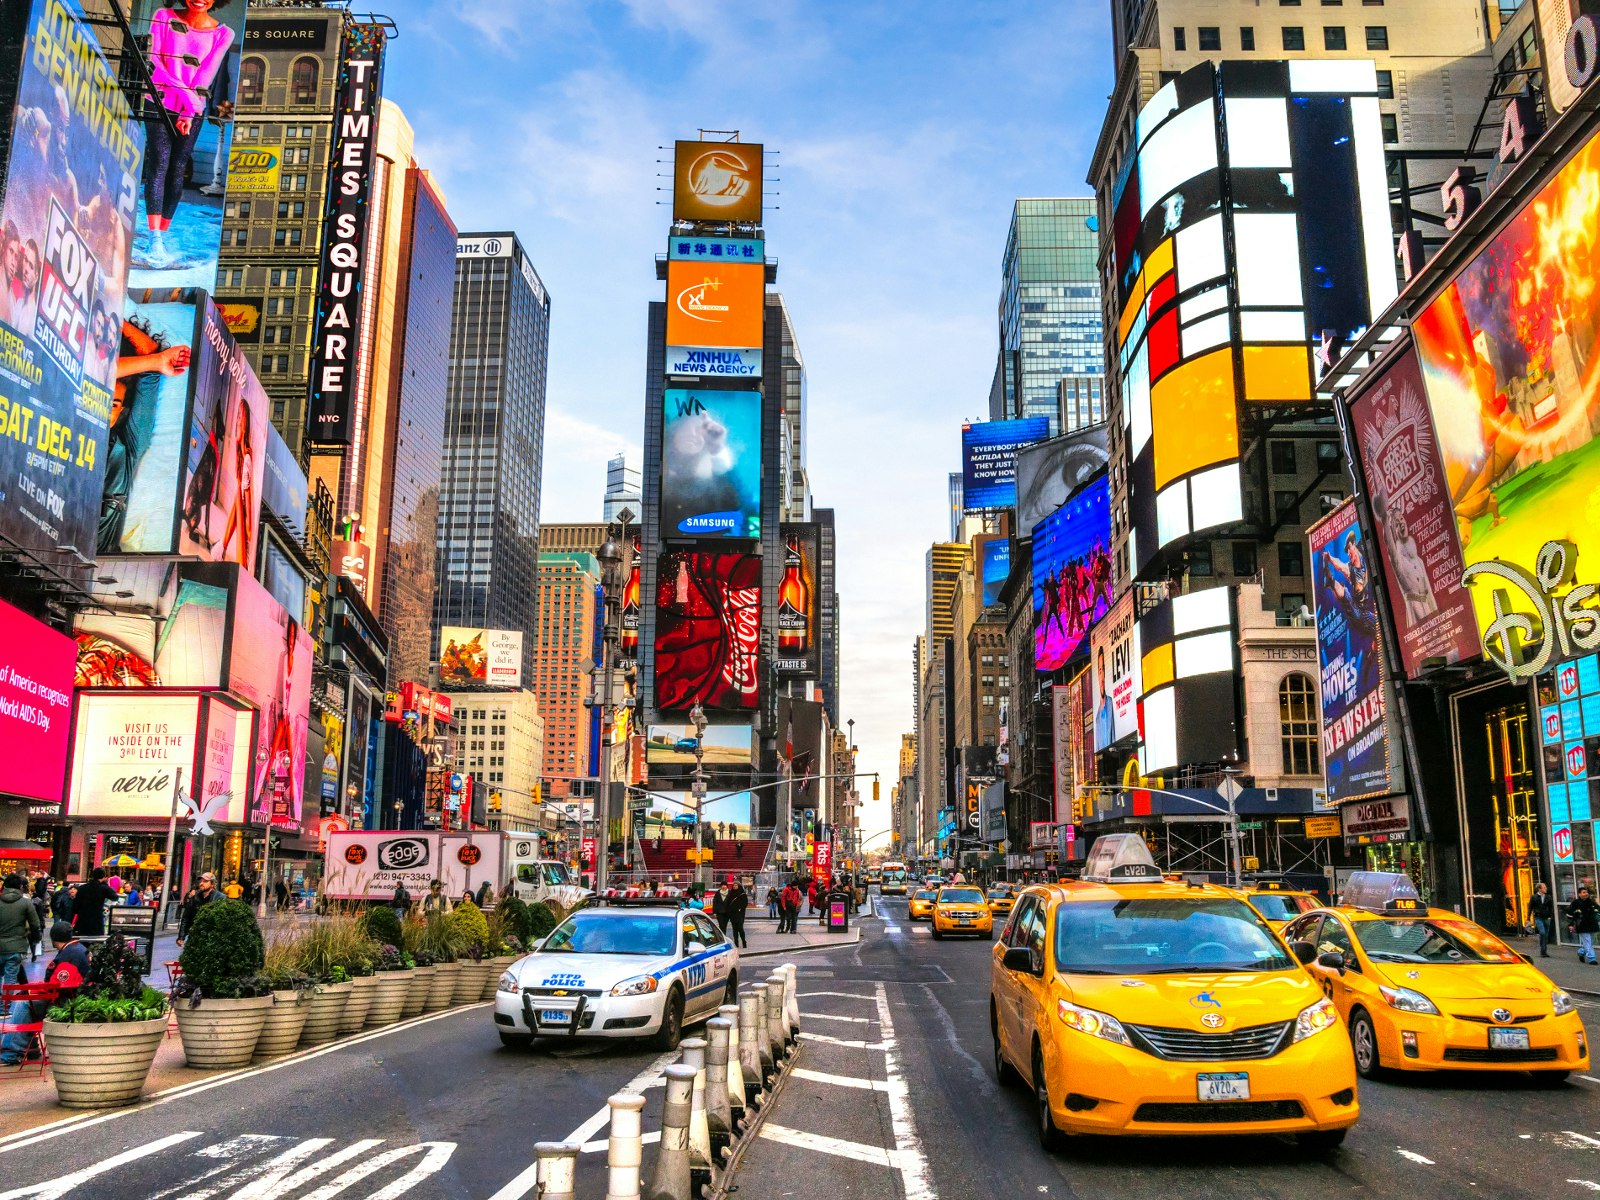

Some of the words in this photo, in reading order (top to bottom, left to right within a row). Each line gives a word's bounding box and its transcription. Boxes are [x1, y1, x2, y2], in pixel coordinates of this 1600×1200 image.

[265, 30, 315, 39] SQUARE
[38, 0, 130, 130] JOHNSON
[33, 22, 141, 179] BENAVIDEZ
[340, 60, 374, 196] TIMES
[118, 171, 137, 232] 2
[46, 211, 97, 308] FOX
[678, 242, 755, 257] 新华通讯社
[321, 213, 358, 392] SQUARE
[41, 281, 88, 354] UFC
[36, 318, 82, 382] SATURDAY
[687, 351, 742, 365] XINHUA
[674, 363, 707, 373] NEWS
[709, 364, 755, 375] AGENCY
[37, 415, 73, 463] DEC.
[76, 433, 97, 472] 14
[1383, 434, 1412, 474] GREAT
[971, 453, 1001, 462] MATILDA
[975, 462, 994, 470] THEY
[974, 471, 997, 479] KNOW
[998, 469, 1015, 477] HOW
[1385, 452, 1418, 494] COMET
[19, 472, 36, 499] LIVE
[36, 487, 47, 507] ON
[46, 488, 66, 522] FOX
[686, 518, 735, 528] SAMSUNG
[1432, 555, 1459, 580] ORIGINAL
[491, 641, 518, 650] George,
[501, 633, 510, 642] By
[495, 655, 506, 664] did
[1111, 637, 1131, 683] LEVI
[1265, 648, 1288, 659] THE
[1292, 648, 1316, 659] SHO
[1321, 652, 1345, 680] NOTHING
[0, 665, 10, 682] of
[9, 668, 37, 694] America
[38, 684, 70, 708] recognizes
[1322, 656, 1358, 709] MOVES
[1345, 684, 1357, 706] LIKE
[0, 695, 19, 718] World
[18, 703, 37, 724] AIDS
[125, 723, 151, 733] VISIT
[155, 723, 168, 733] US
[1323, 684, 1384, 758] NEWSIES
[108, 735, 142, 746] INSIDE
[146, 735, 160, 746] ON
[164, 736, 182, 746] THE
[120, 748, 136, 758] 3RD
[139, 748, 168, 759] LEVEL
[1347, 746, 1356, 762] ON
[112, 769, 170, 793] aerie
[1358, 801, 1394, 821] DIGITAL
[1389, 833, 1406, 841] SONY
[388, 847, 419, 862] edge
[817, 843, 829, 865] tkts
[391, 873, 431, 881] 947-3343
[1396, 900, 1416, 909] 7L66
[541, 979, 586, 987] POLICE
[688, 962, 706, 988] NYPD
[543, 1010, 563, 1020] 4135
